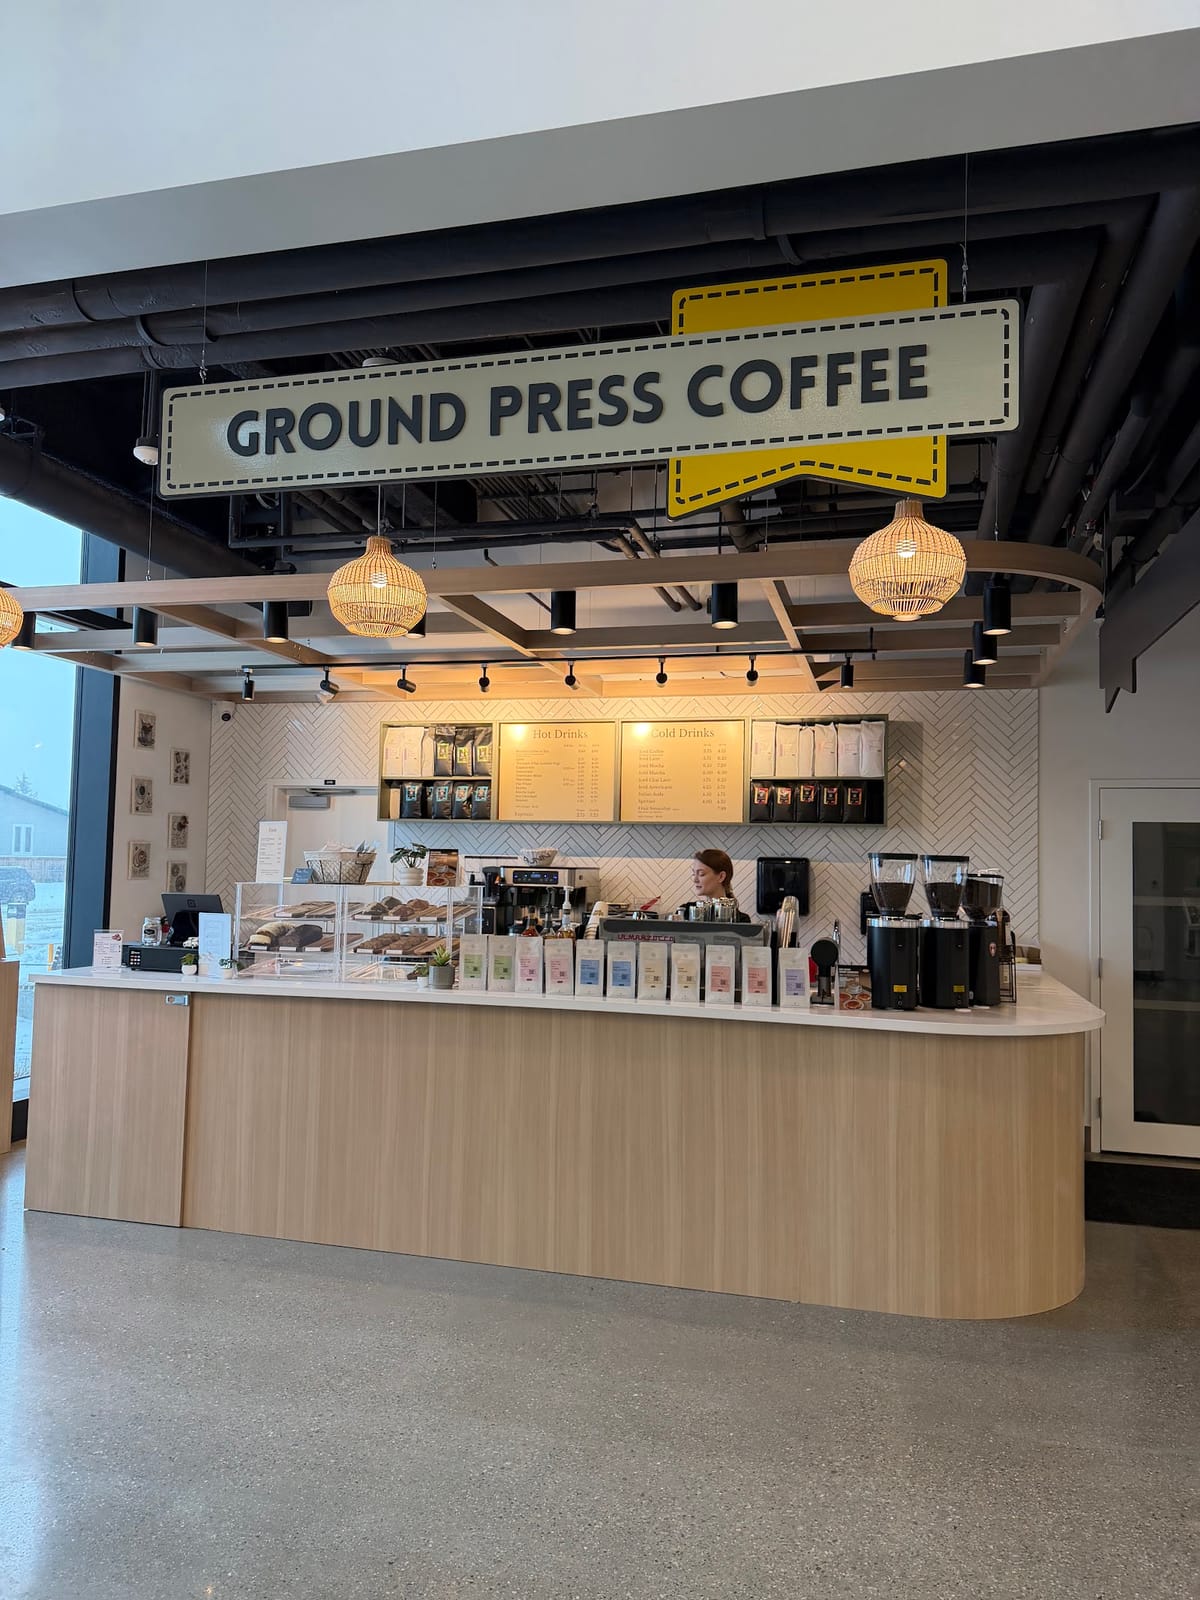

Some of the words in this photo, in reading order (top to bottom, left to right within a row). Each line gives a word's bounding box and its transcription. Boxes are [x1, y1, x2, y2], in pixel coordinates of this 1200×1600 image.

[227, 392, 466, 457] GROUND
[490, 371, 664, 437] PRESS
[687, 344, 928, 418] COFFEE
[533, 729, 551, 739] Hot
[554, 729, 588, 739] Drinks
[651, 728, 676, 738] Cold
[679, 728, 714, 738] Drinks
